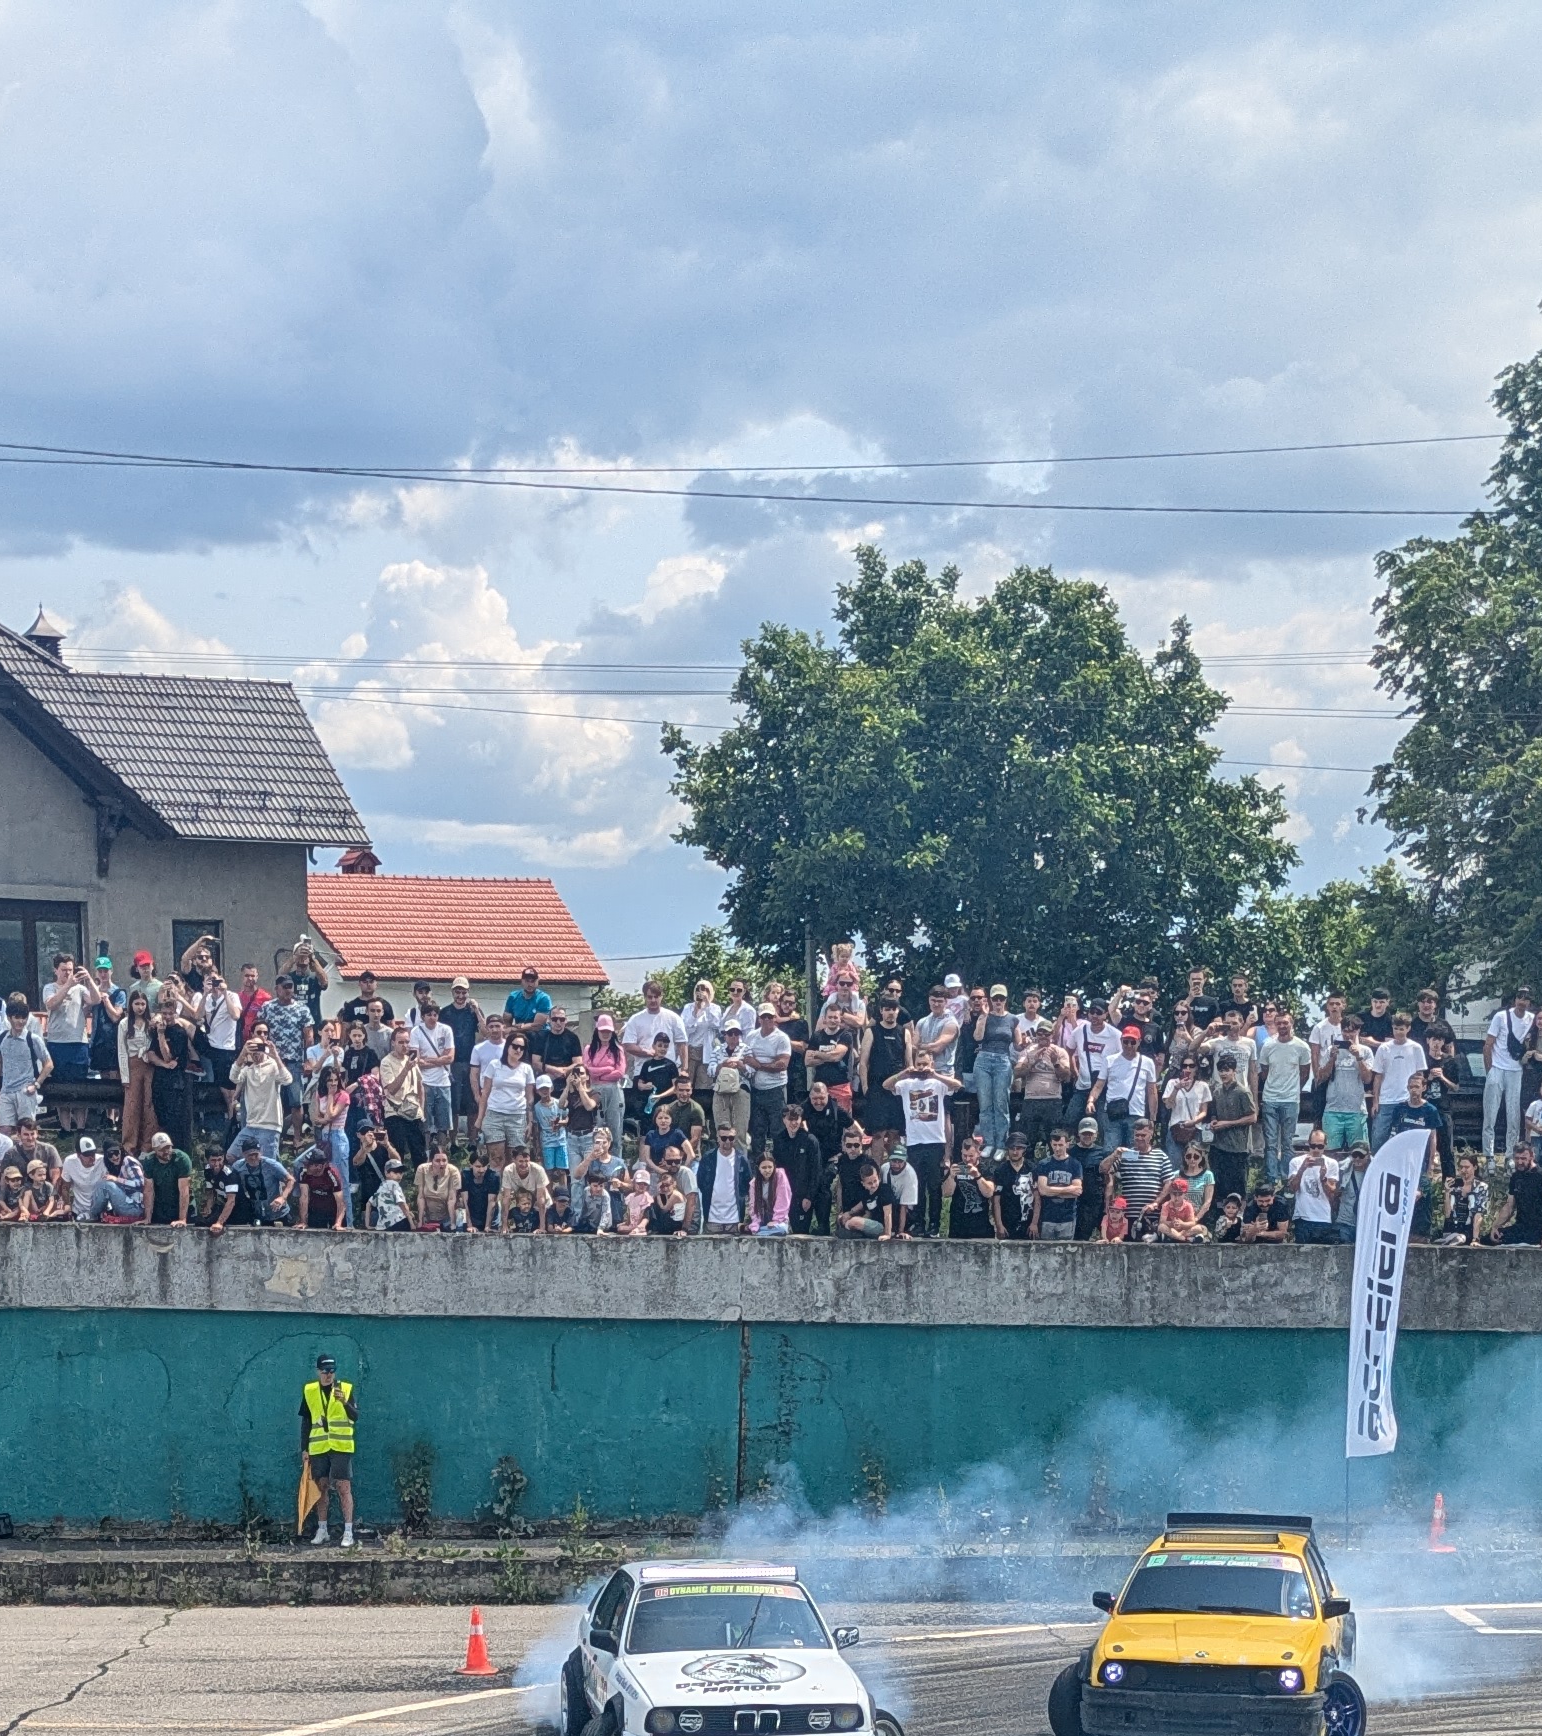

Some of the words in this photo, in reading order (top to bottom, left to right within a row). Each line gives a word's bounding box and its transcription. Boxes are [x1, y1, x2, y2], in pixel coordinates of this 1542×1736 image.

[670, 1585, 708, 1595] DYNAMIC
[710, 1585, 735, 1594] DRIFT
[736, 1585, 775, 1595] MOLDOVA
